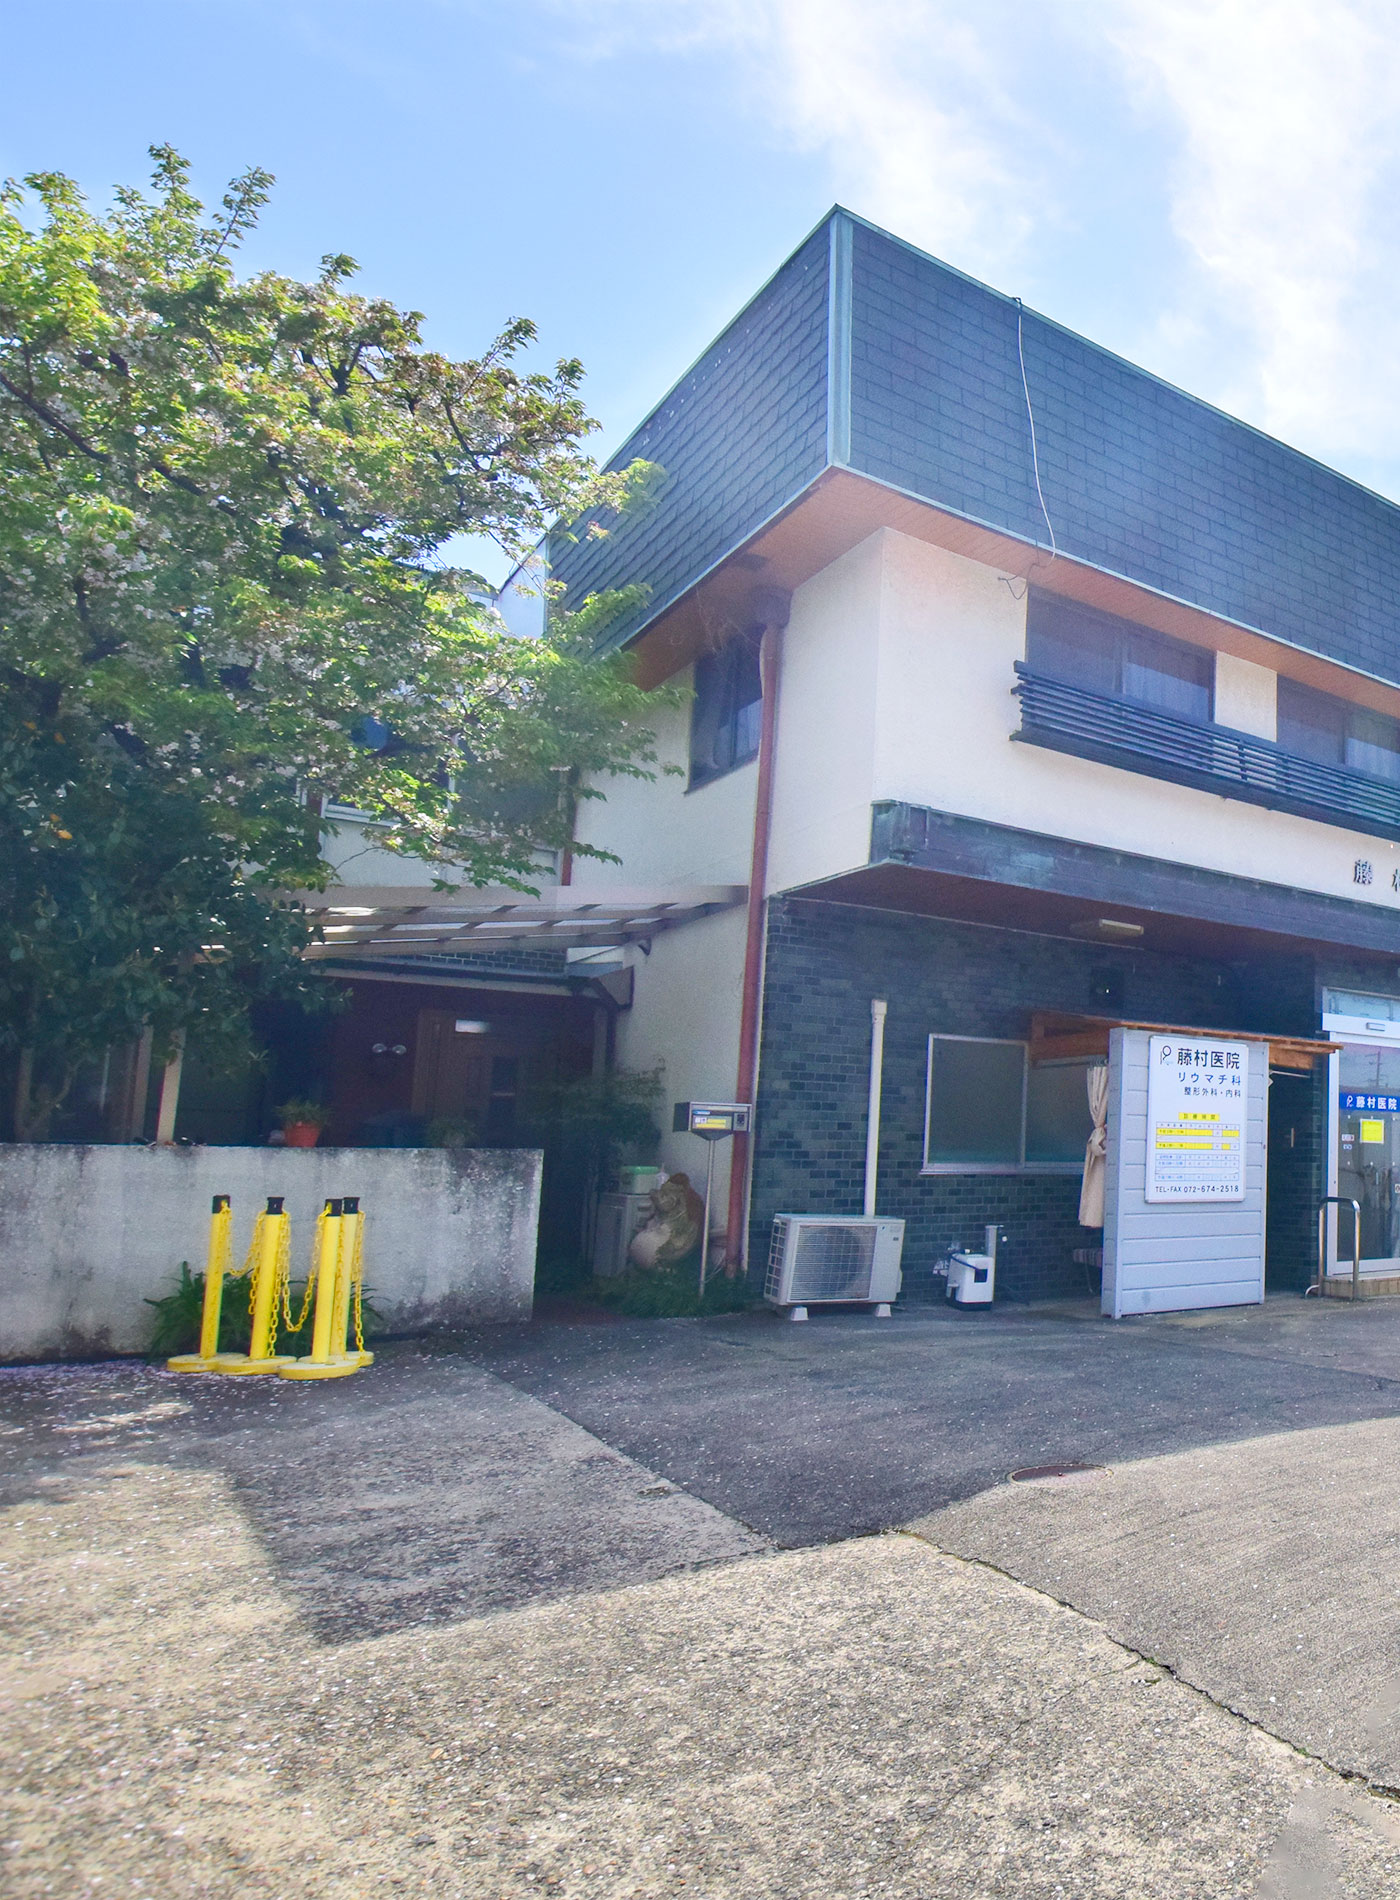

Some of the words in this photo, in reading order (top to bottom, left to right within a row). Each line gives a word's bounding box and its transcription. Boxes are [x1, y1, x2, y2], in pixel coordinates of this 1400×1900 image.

[1177, 1047, 1240, 1070] 藤村医院
[1178, 1072, 1240, 1085] リウマチ科
[1184, 1086, 1240, 1097] 整形外科・内科
[1356, 1096, 1397, 1110] 藤村医院
[1183, 1185, 1239, 1193] 072-674-2518
